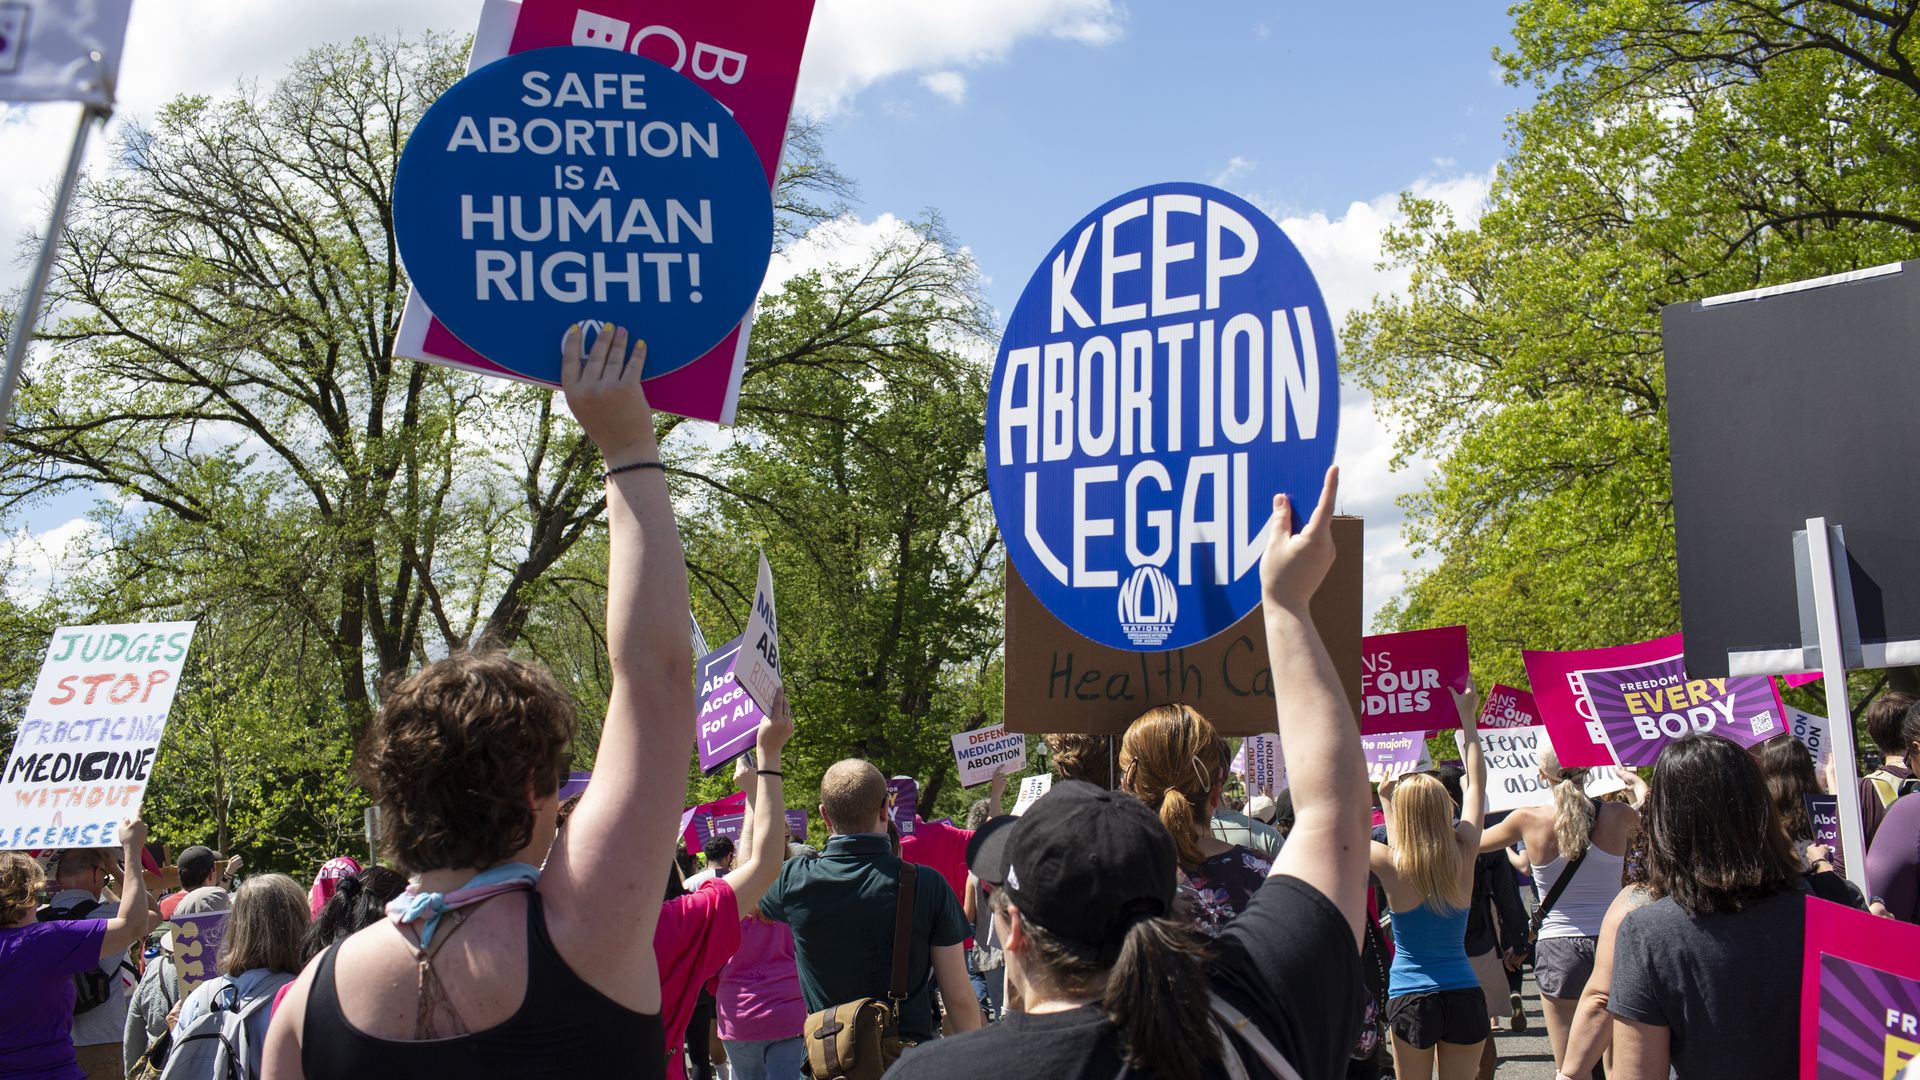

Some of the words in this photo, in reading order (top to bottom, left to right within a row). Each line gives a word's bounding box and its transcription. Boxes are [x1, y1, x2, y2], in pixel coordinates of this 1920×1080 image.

[520, 70, 648, 110] SAFE
[446, 116, 720, 159] ABORTION
[554, 165, 585, 190] IS
[594, 166, 620, 191] A
[461, 194, 714, 244] HUMAN
[475, 249, 703, 304] RIGHT!
[1051, 193, 1260, 334] KEEP
[999, 305, 1320, 466] ABORTION
[1024, 452, 1275, 588] LEGAL
[1117, 566, 1178, 623] NOW
[53, 632, 189, 663] JUDGES
[1362, 651, 1393, 673] NS
[1048, 649, 1202, 701] Health
[1221, 635, 1277, 698] Ca
[1376, 668, 1442, 693] OUR
[1620, 675, 1679, 692] FREEDOM
[48, 669, 171, 705] STOP
[1361, 690, 1431, 716] DIES
[1623, 677, 1728, 715] EVERY
[17, 713, 166, 746] PRACTICING
[702, 714, 729, 739] For
[732, 698, 754, 722] All
[1504, 707, 1533, 726] OUR
[1633, 693, 1736, 740] BODY
[958, 735, 1024, 760] MEDICATION
[968, 748, 1020, 770] ABORTION
[1377, 737, 1413, 751] majority
[8, 747, 156, 784] MEDICINE
[1248, 747, 1256, 784] DEFEND
[15, 785, 143, 808] WITHOUT
[52, 811, 63, 828] A
